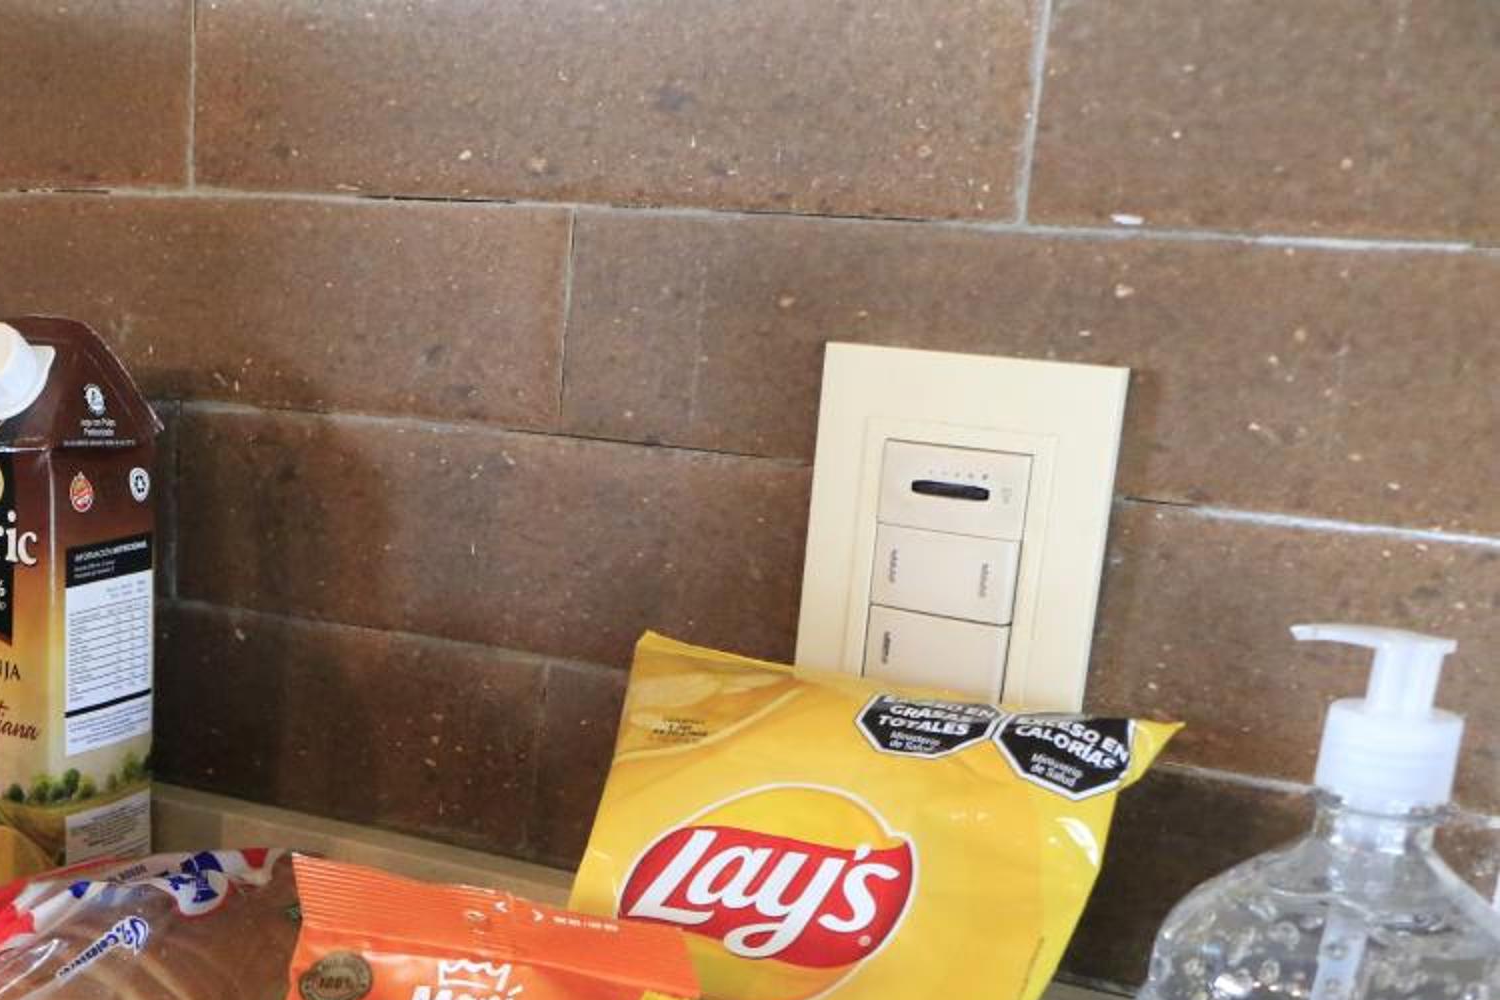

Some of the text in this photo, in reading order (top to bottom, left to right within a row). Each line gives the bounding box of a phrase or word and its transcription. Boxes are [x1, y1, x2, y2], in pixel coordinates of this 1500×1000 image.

[878, 714, 971, 736] TOTALES
[1101, 736, 1129, 763] EN
[627, 829, 901, 959] Lay's
